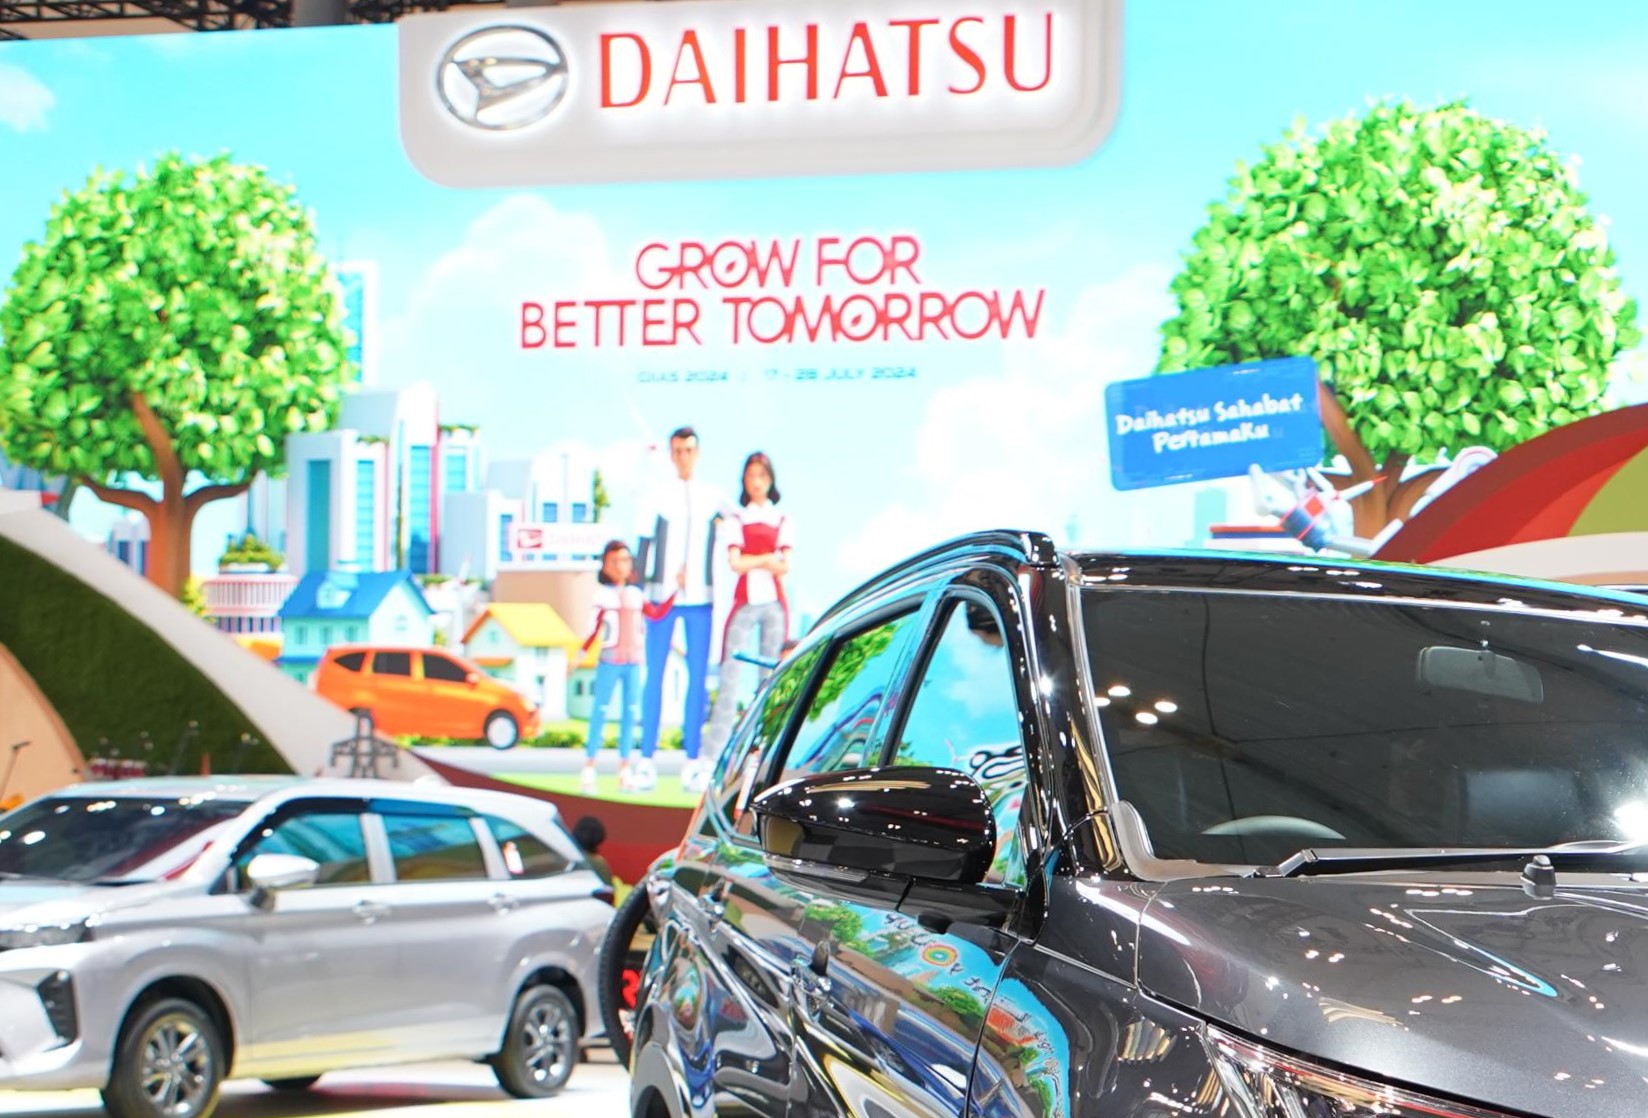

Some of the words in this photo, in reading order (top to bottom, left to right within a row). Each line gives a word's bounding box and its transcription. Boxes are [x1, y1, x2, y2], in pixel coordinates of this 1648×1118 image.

[598, 11, 1053, 109] DAIHATSU
[635, 238, 801, 291] GROW
[816, 235, 922, 287] FOR
[520, 297, 703, 350] BETTER
[721, 288, 1046, 345] TOMORROW
[795, 368, 818, 382] 28
[870, 366, 917, 381] 2024
[1115, 408, 1210, 436] Daihatsu
[1213, 393, 1303, 422] Sahabat
